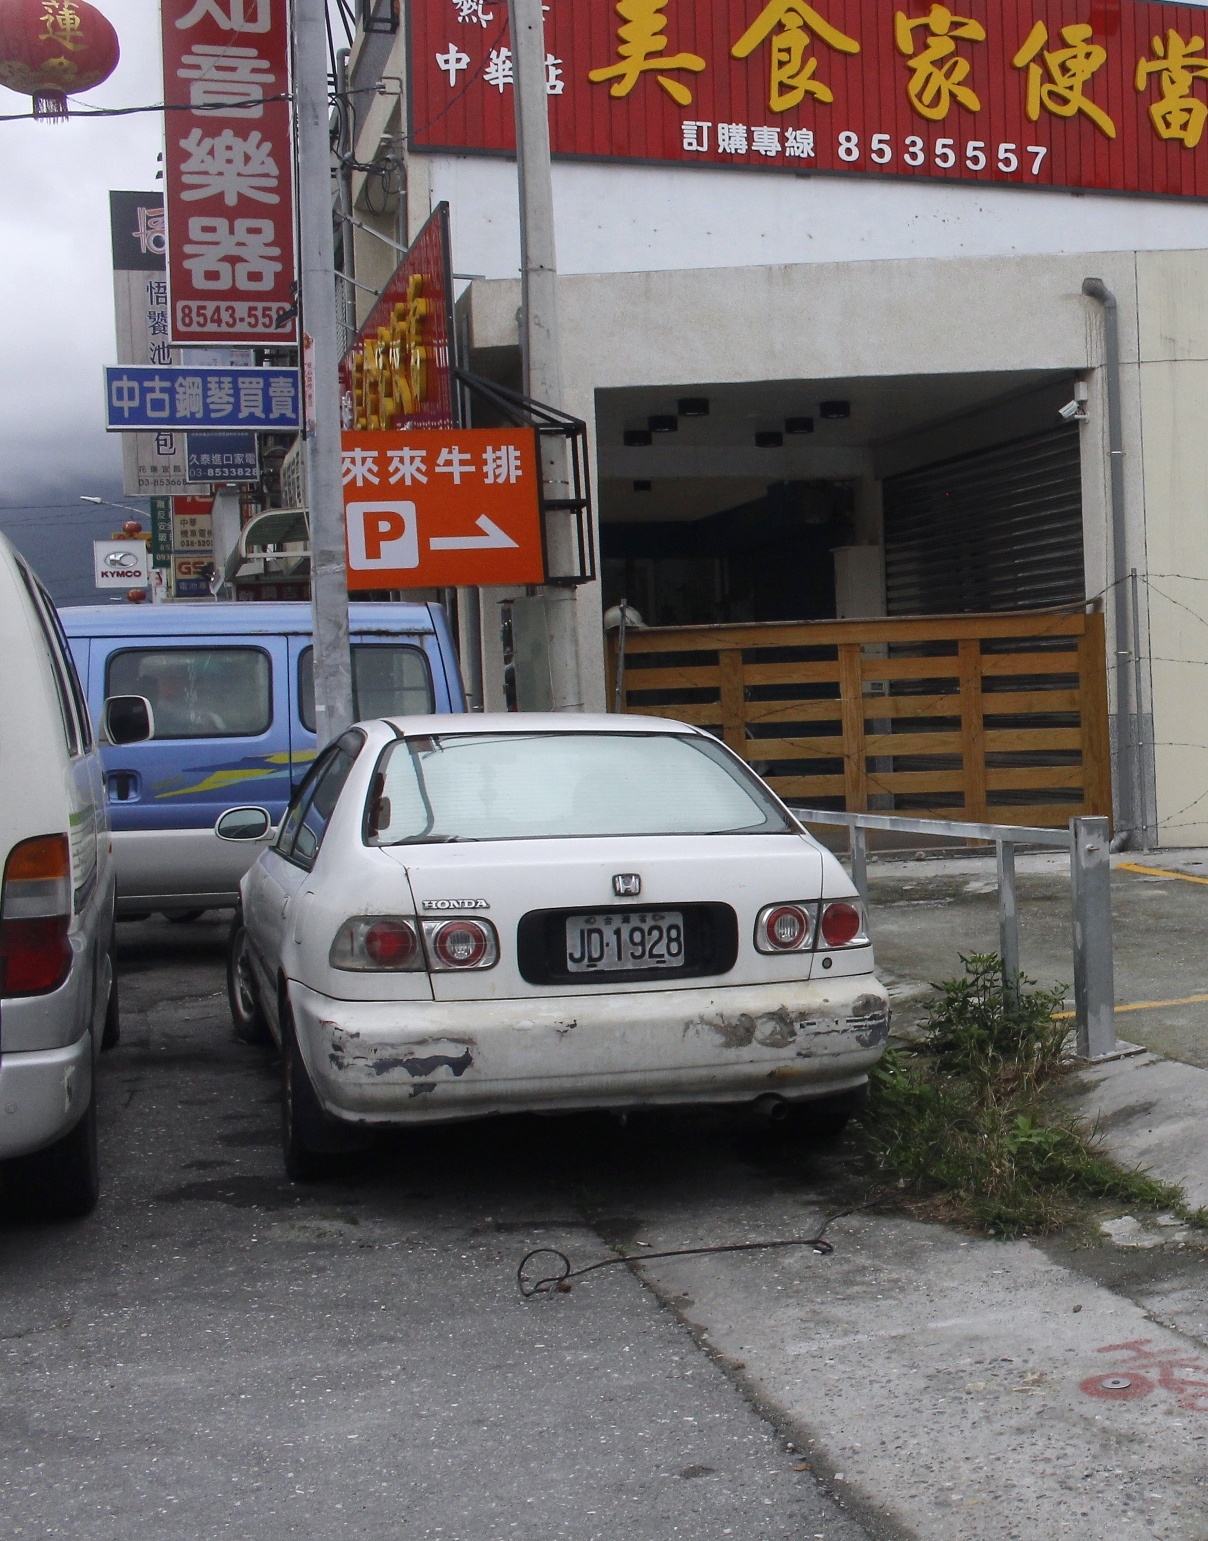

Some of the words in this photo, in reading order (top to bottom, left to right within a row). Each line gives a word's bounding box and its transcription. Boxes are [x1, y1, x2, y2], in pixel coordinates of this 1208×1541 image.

[681, 120, 816, 159] 訂購專線
[837, 130, 1049, 175] 8535557
[111, 374, 296, 420] 中古鋼琴買賣
[341, 445, 523, 486] 來來牛排
[363, 511, 406, 560] P
[101, 570, 142, 578] KYMCO
[422, 899, 490, 909] HONDA
